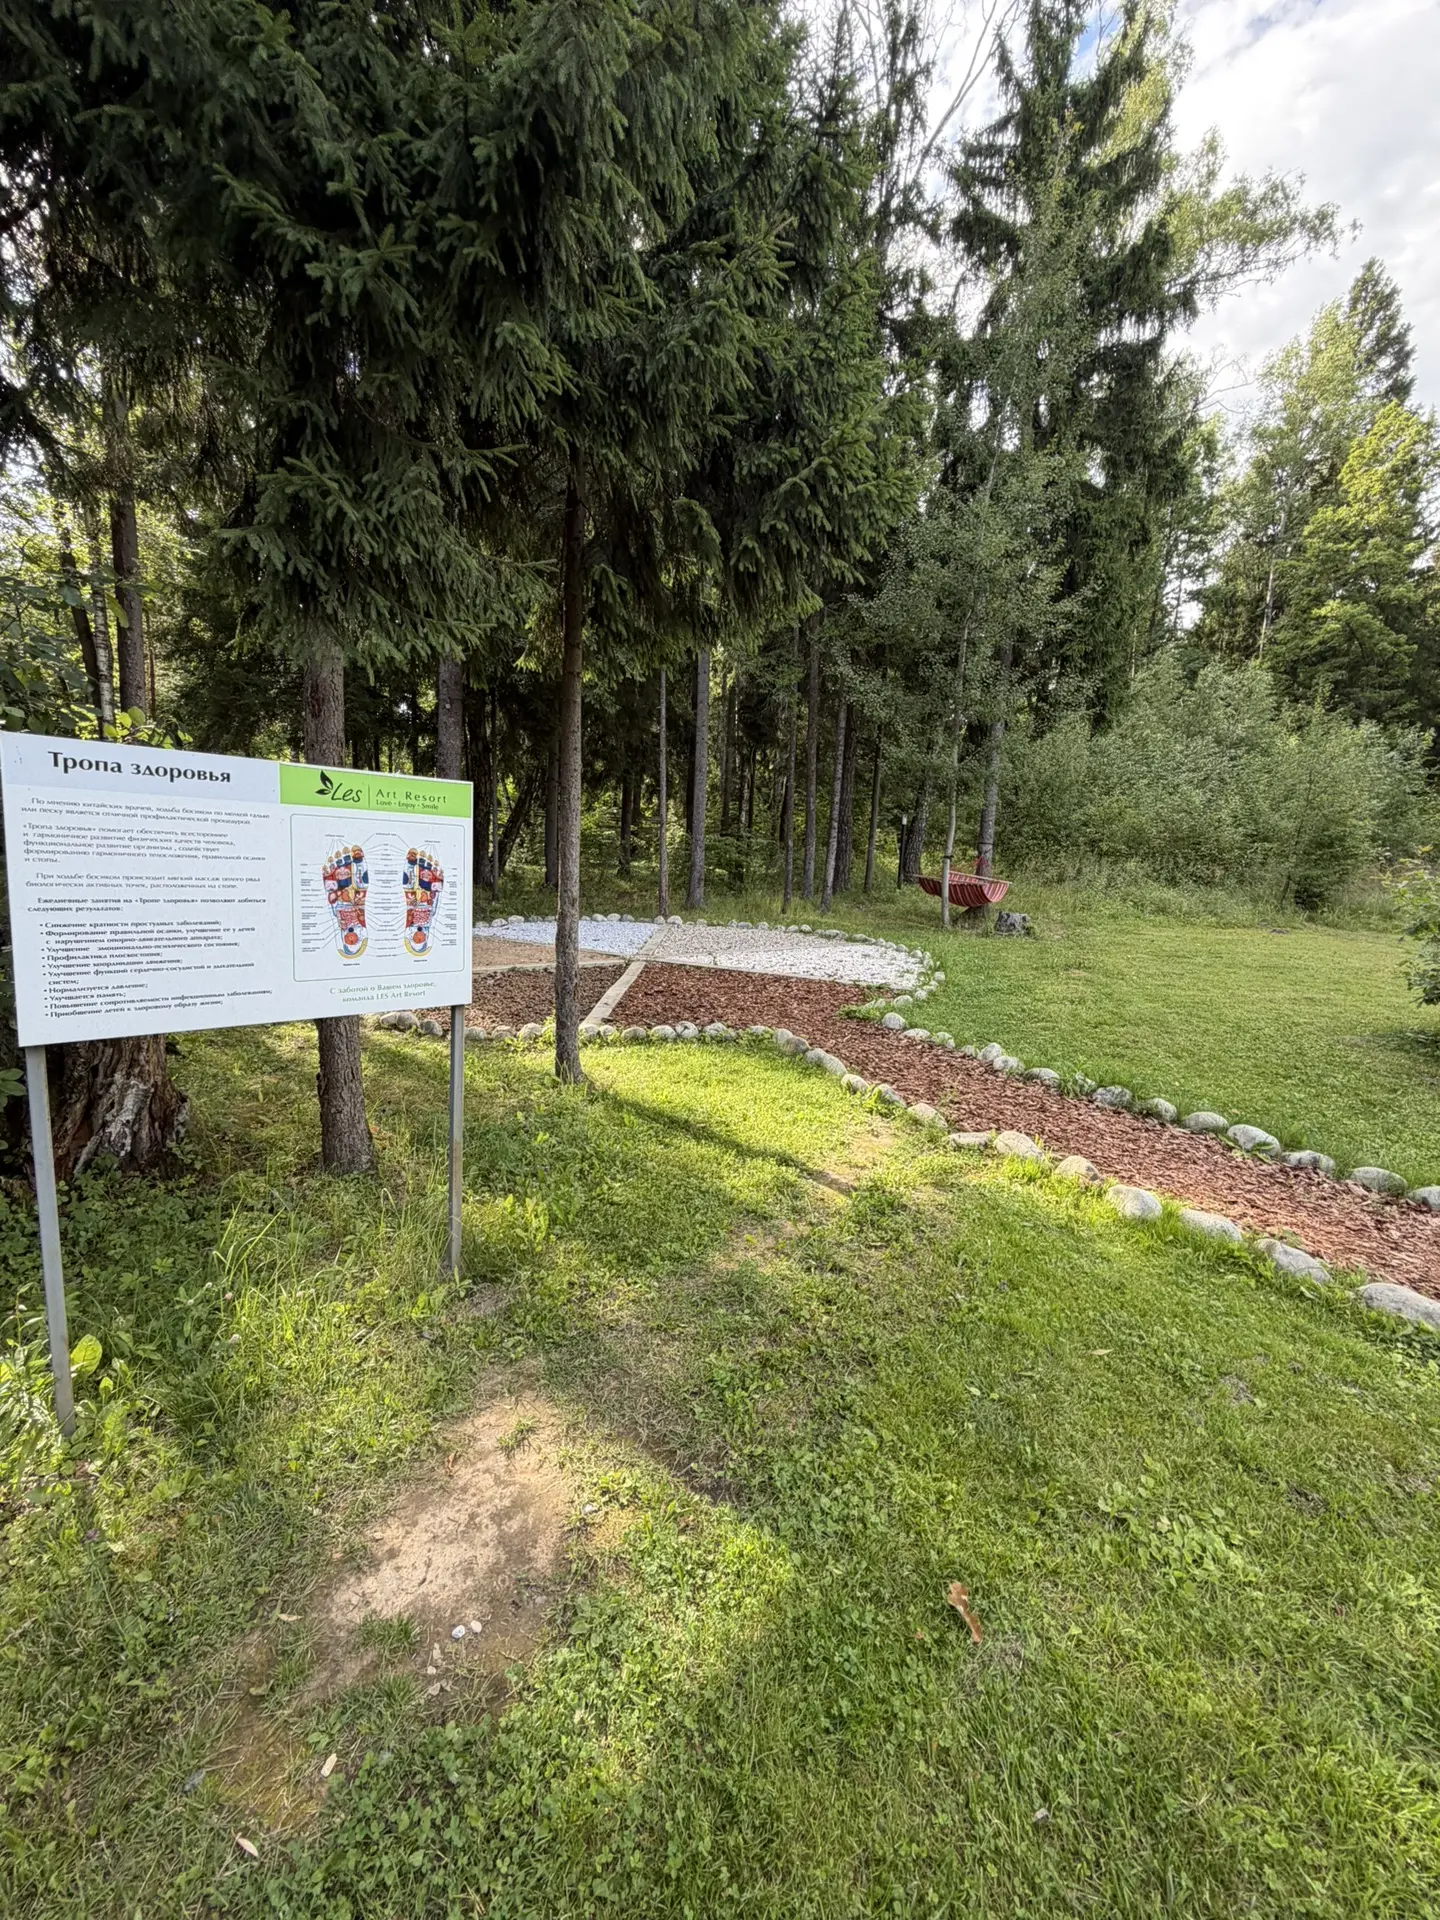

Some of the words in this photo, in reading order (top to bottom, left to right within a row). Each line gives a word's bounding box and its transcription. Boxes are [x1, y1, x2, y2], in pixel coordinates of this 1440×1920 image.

[48, 751, 122, 774] Тропа
[130, 763, 230, 783] здоровья
[331, 783, 362, 803] Les
[376, 789, 396, 798] Art
[406, 792, 446, 803] Resort
[24, 840, 94, 848] функциональное
[49, 985, 109, 994] Нормализуется
[50, 1001, 98, 1009] Повышение
[50, 1009, 102, 1018] Приобщение
